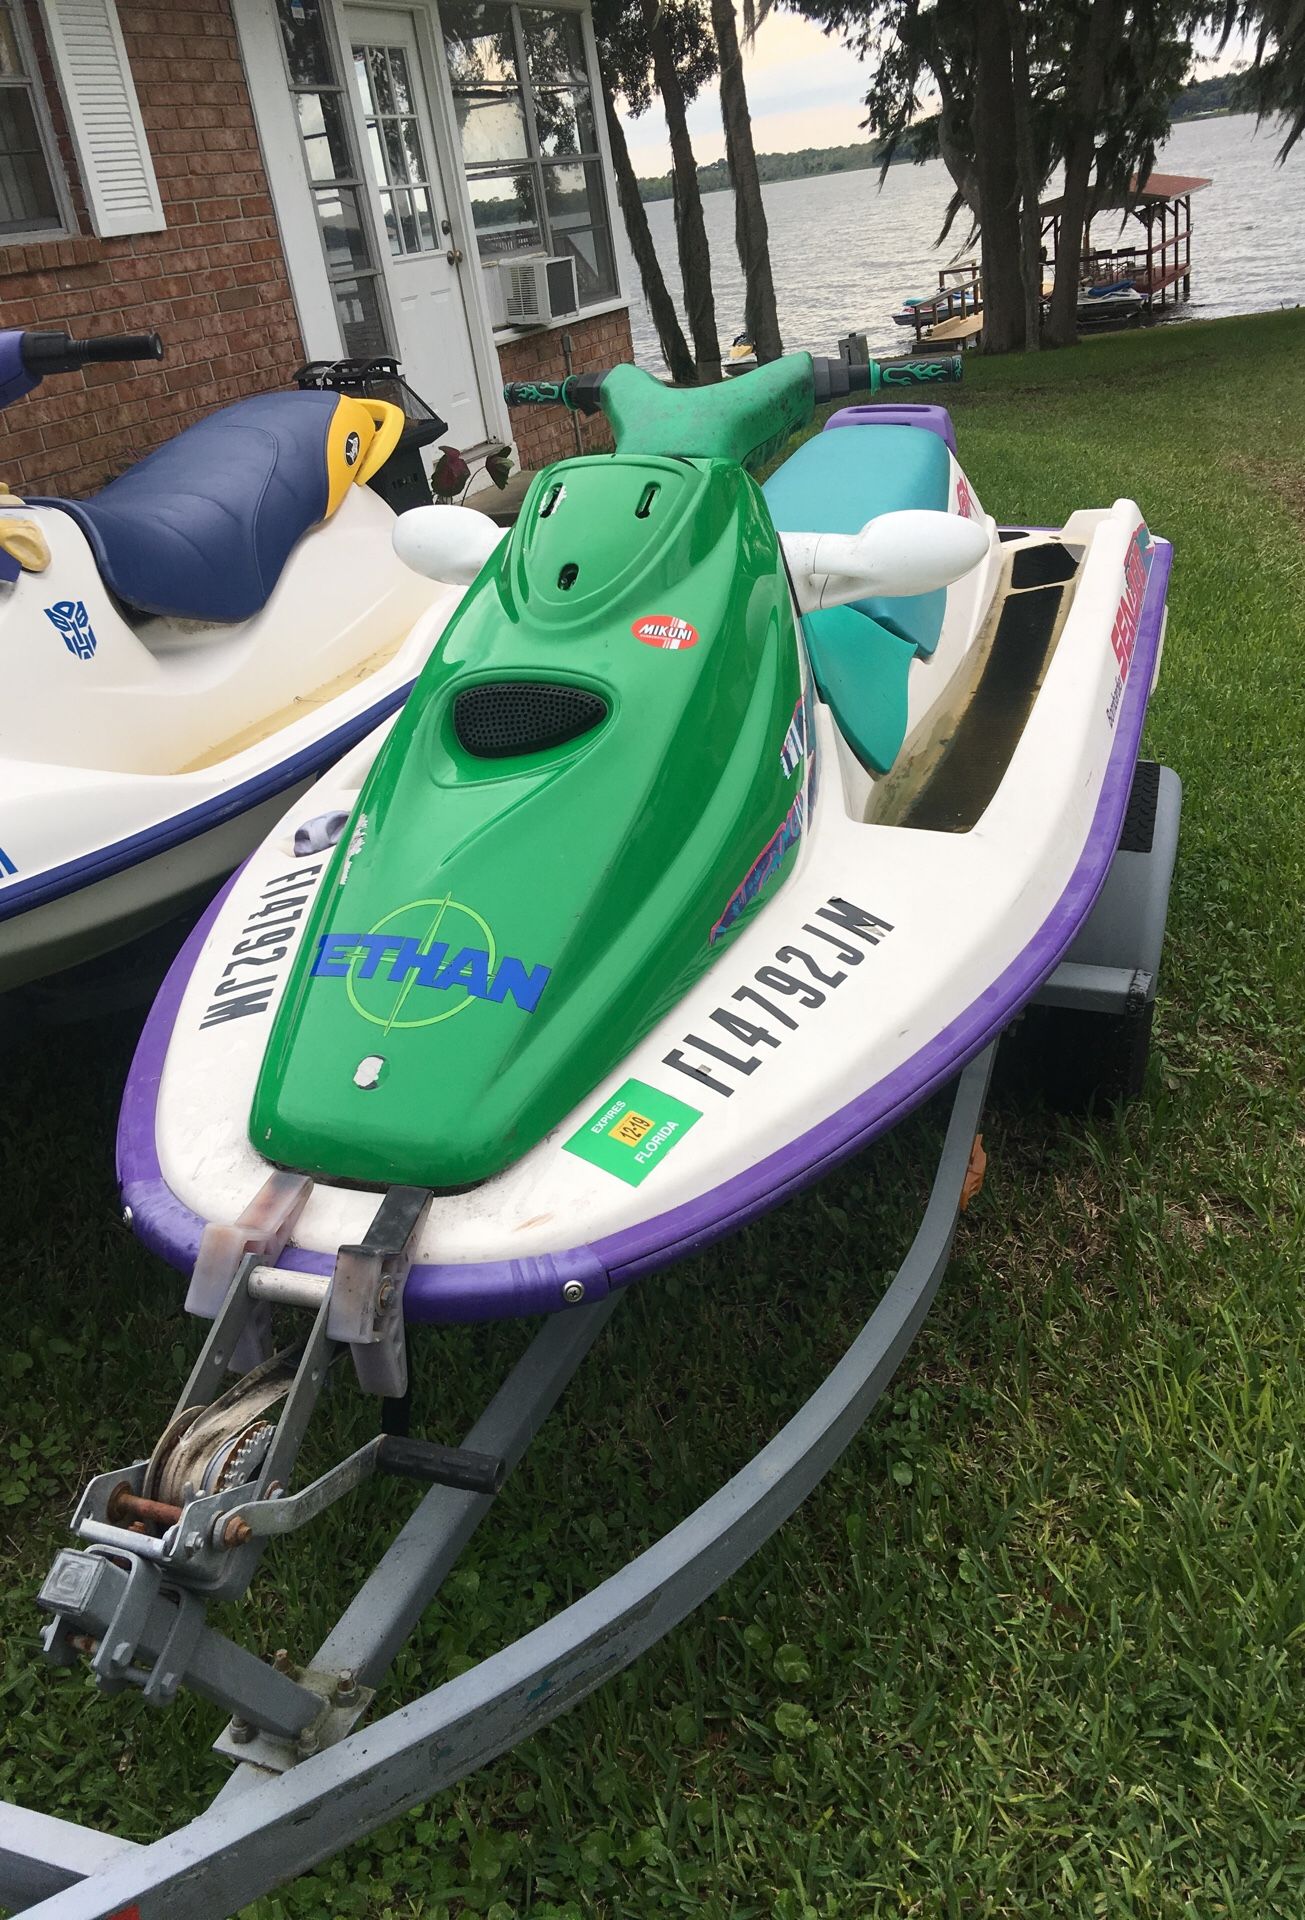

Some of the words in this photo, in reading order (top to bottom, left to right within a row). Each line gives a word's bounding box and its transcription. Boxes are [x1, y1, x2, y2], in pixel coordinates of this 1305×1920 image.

[639, 624, 693, 641] MIKUNI
[309, 933, 552, 1014] ETHAN
[661, 896, 895, 1098] FL4792JM
[591, 1100, 626, 1134] EXPIRES
[634, 1121, 679, 1164] FLORIDA
